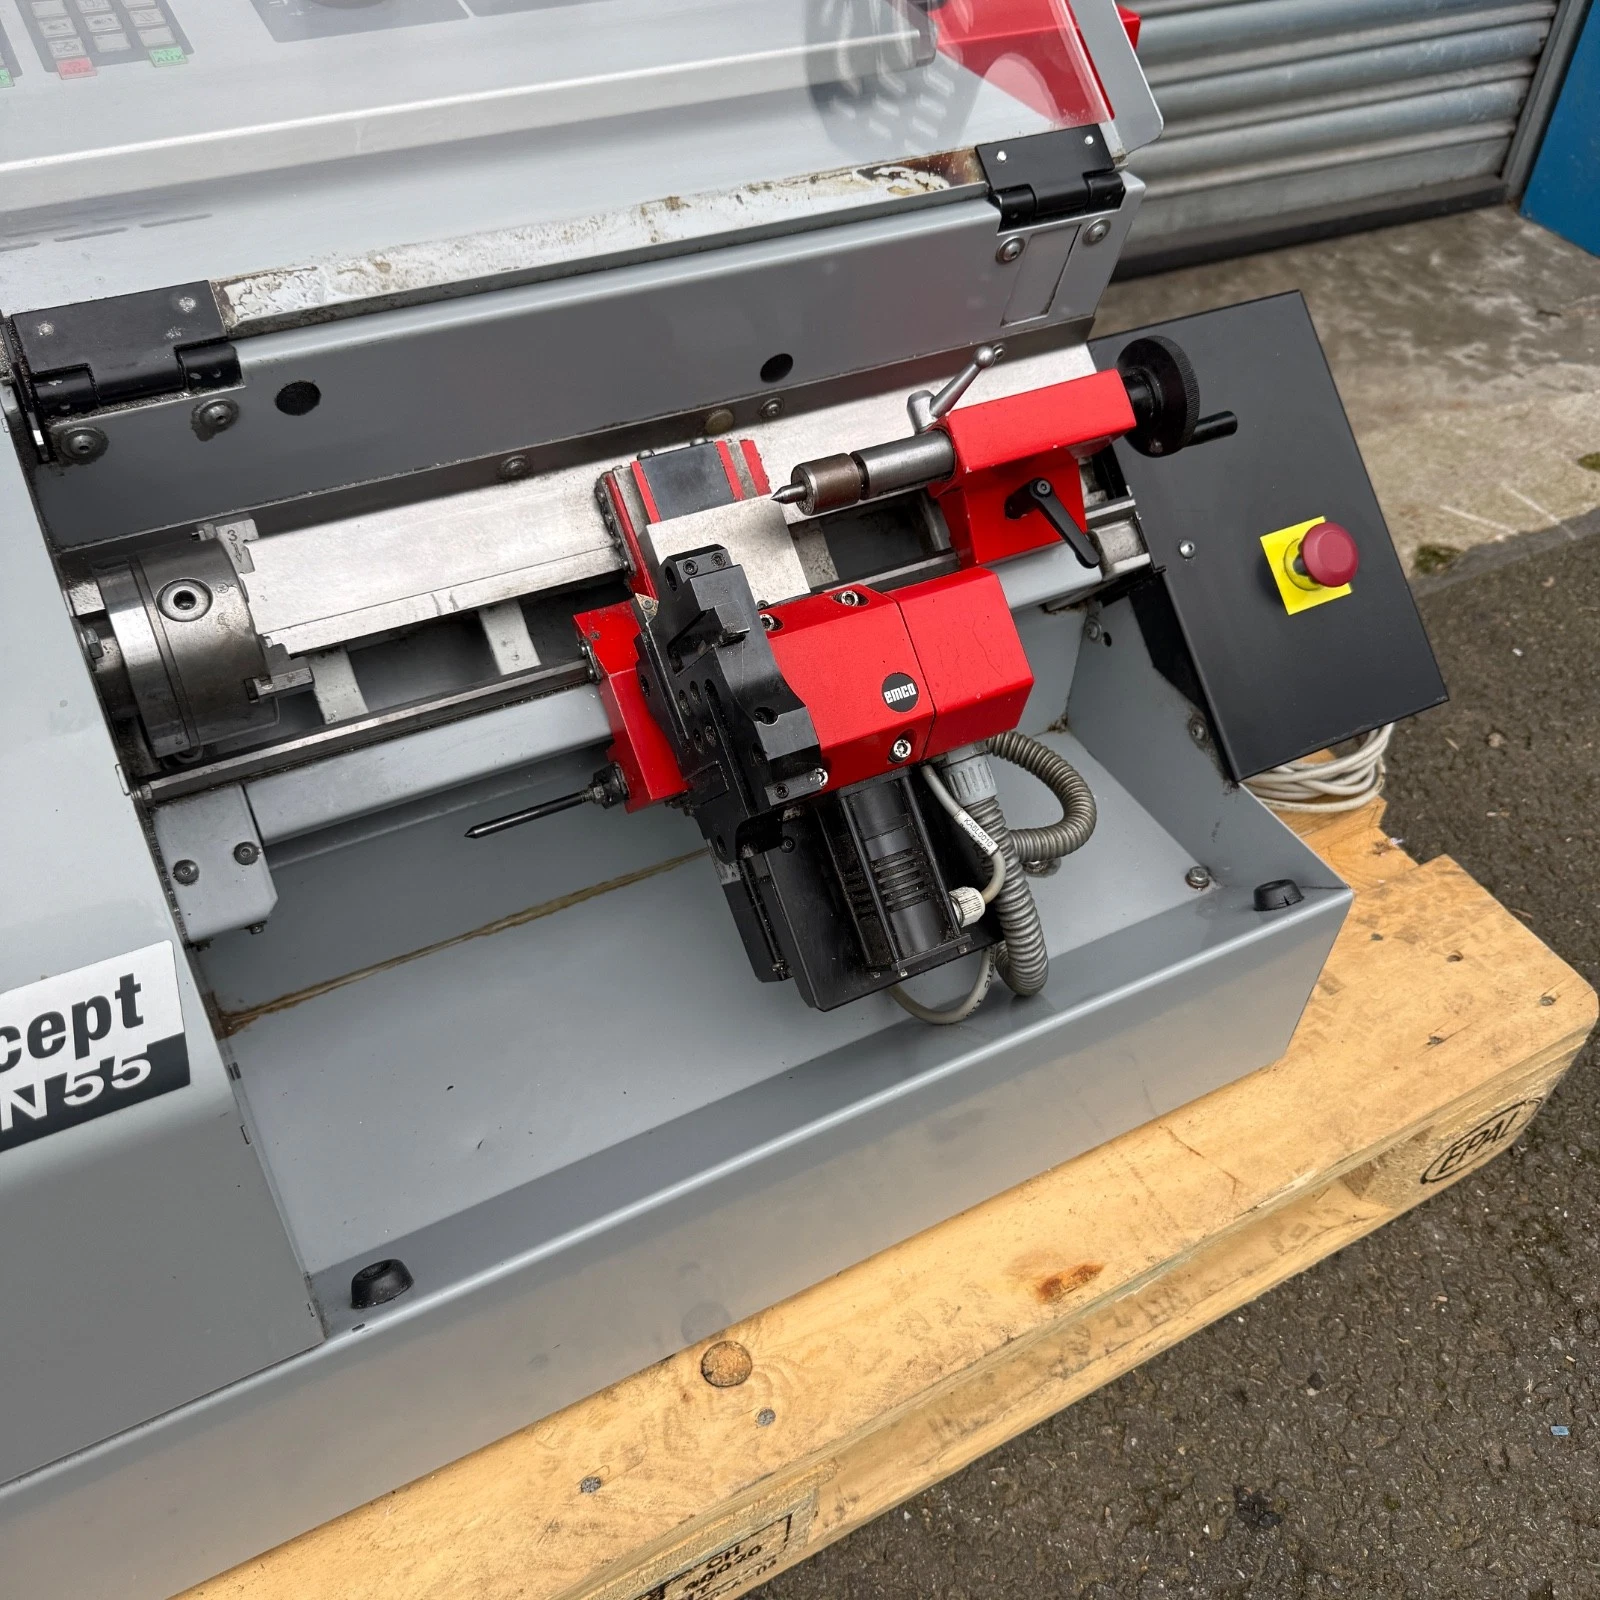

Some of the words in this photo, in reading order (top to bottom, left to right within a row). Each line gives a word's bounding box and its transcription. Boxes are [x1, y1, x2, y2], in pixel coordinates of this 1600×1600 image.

[227, 529, 238, 542] 3
[884, 683, 917, 704] emco
[0, 973, 144, 1073] cept
[1436, 1110, 1519, 1176] EPAL
